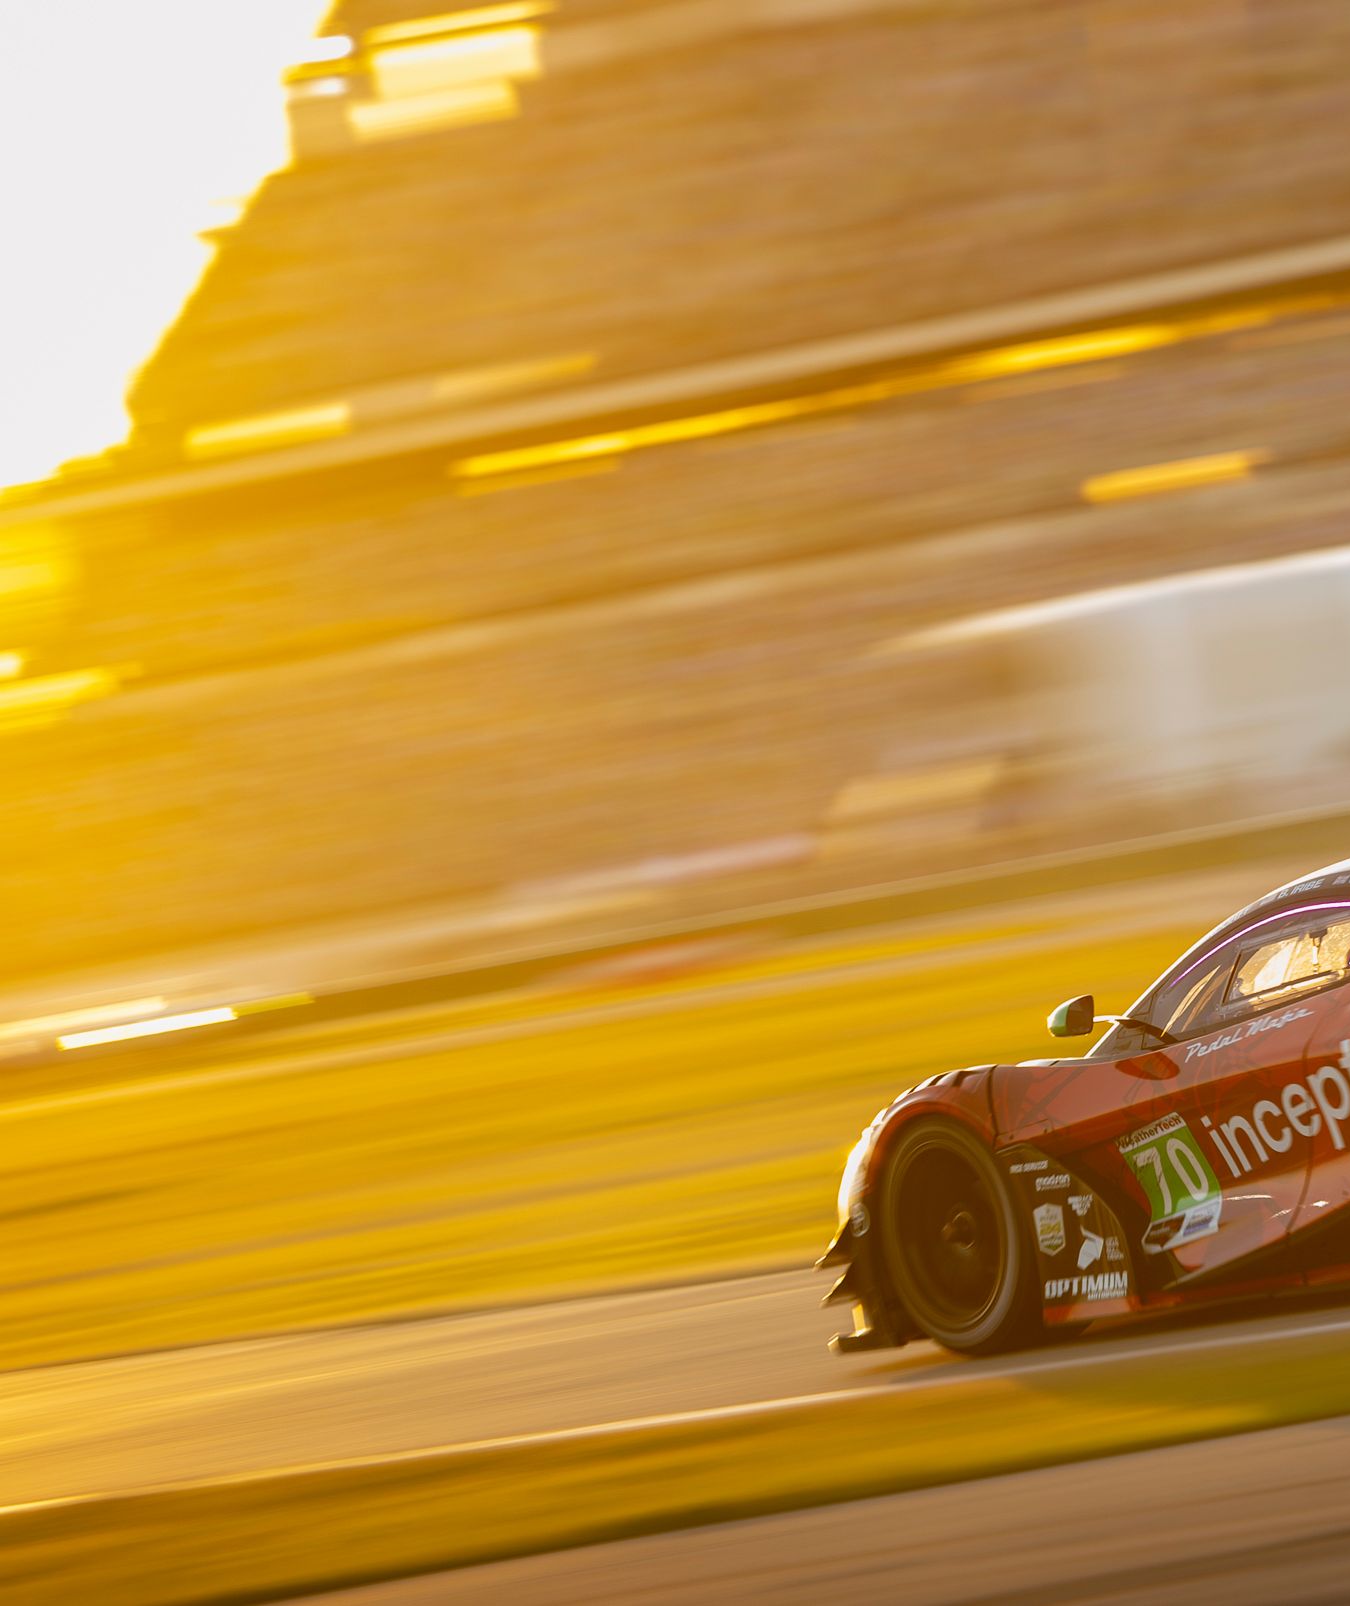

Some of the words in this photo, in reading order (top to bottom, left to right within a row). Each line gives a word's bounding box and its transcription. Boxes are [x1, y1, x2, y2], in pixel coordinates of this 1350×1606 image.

[1116, 1115, 1182, 1149] WeatherTech
[1132, 1137, 1210, 1216] 70
[1044, 1270, 1128, 1300] OPTIMUM
